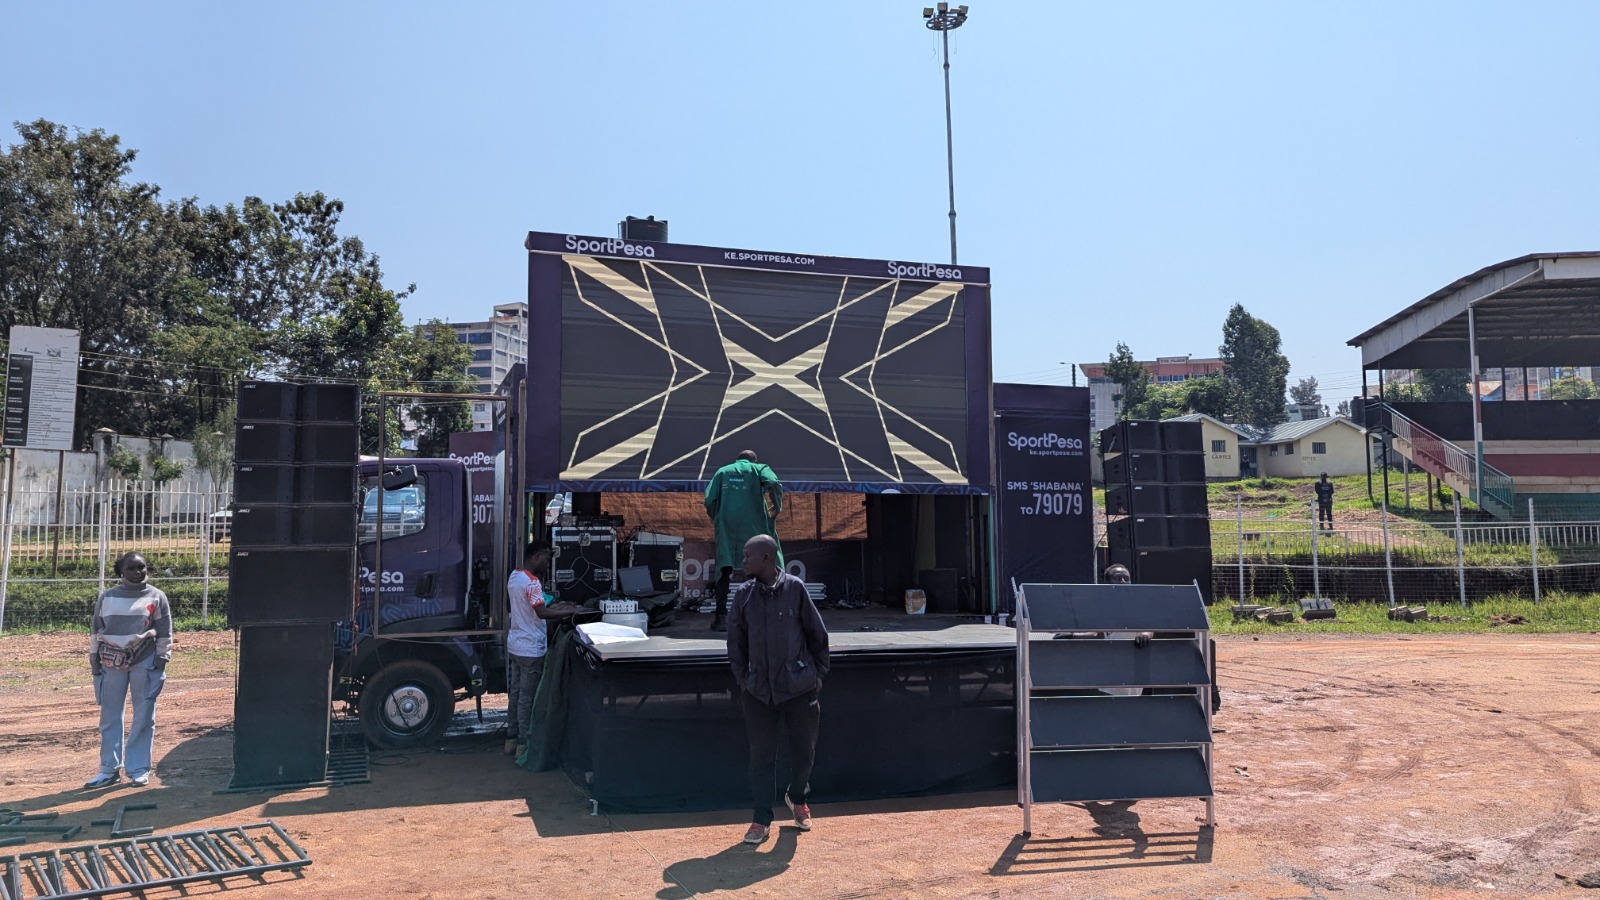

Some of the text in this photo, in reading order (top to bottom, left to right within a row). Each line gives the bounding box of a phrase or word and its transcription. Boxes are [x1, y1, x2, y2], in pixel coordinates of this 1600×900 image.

[565, 233, 655, 257] SportPesa
[724, 251, 815, 265] KE.SPORTPESA.COM
[887, 260, 962, 280] SportPesa
[1007, 431, 1083, 451] SportPesa
[1007, 481, 1028, 490] SMS
[1020, 493, 1083, 515] TO 79079
